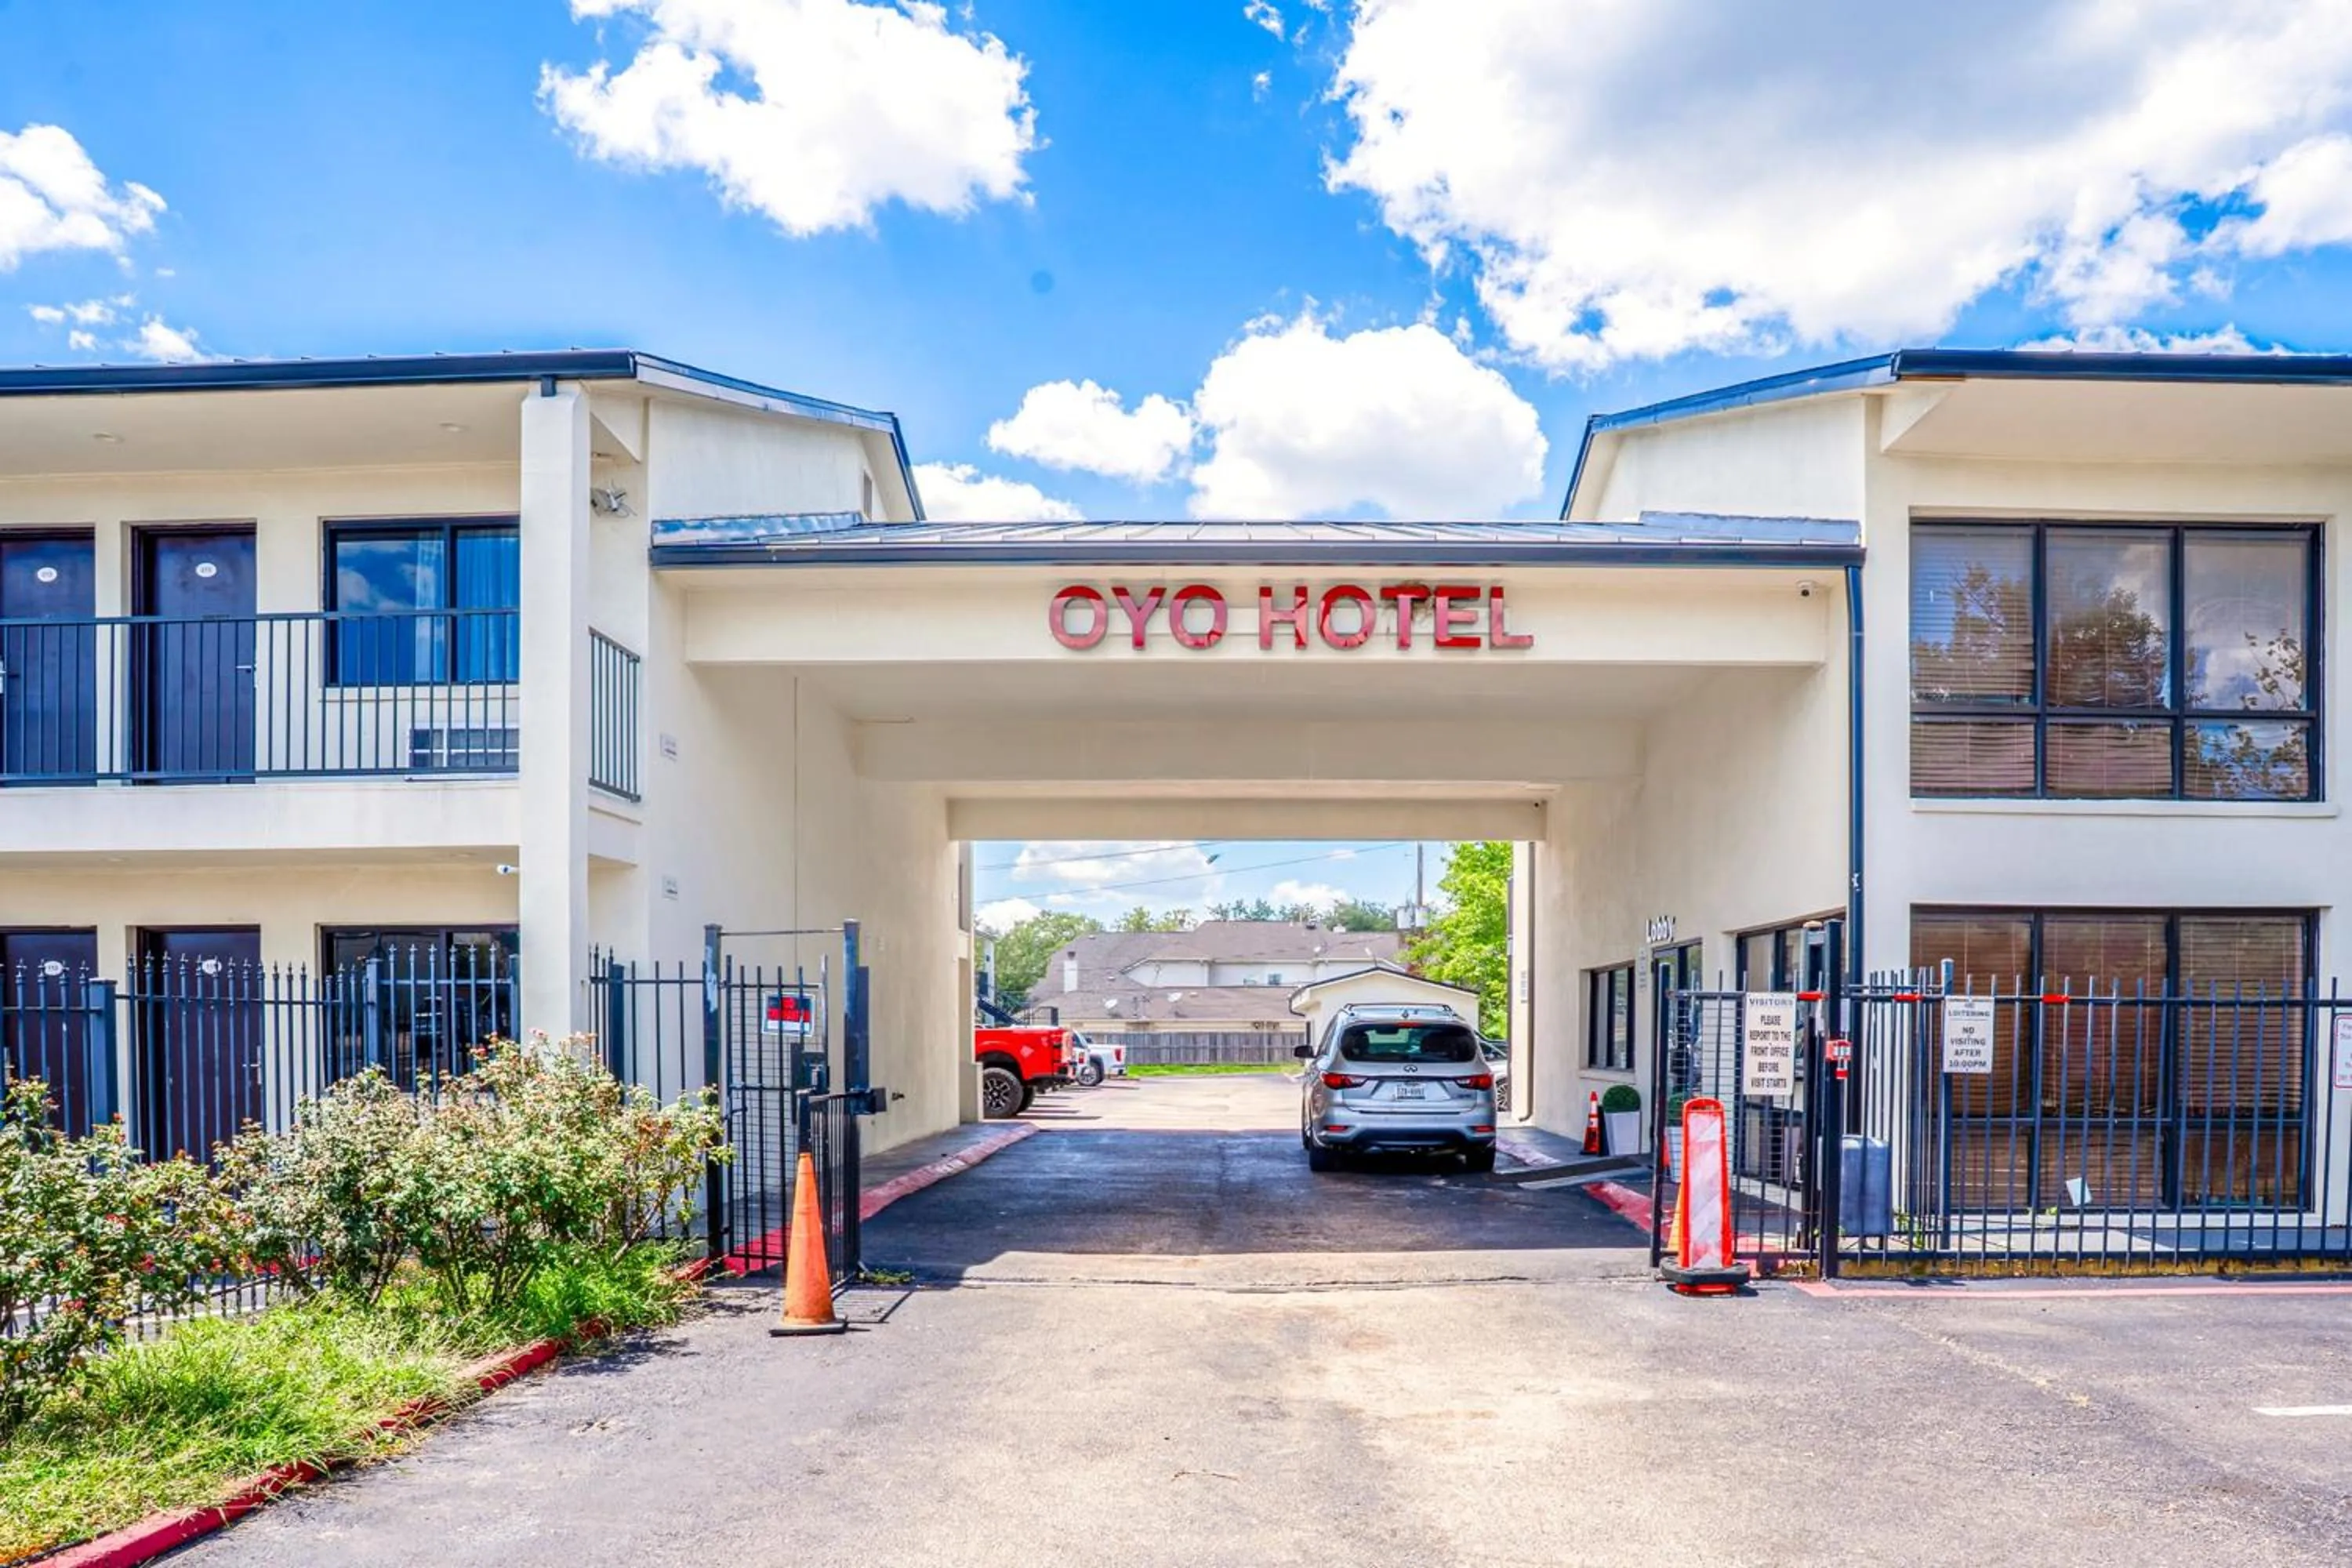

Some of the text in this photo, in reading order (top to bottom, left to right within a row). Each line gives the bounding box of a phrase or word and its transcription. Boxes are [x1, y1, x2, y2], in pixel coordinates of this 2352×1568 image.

[1048, 585, 1534, 651] OYO HOTEL
[1760, 1014, 1781, 1025] PLEASE
[1749, 1030, 1791, 1041] REPORT TO THE
[1751, 1046, 1790, 1057] FRONT OFFICE
[1758, 1062, 1779, 1073] BEFORE
[1751, 1077, 1787, 1088] VISIT STARTS
